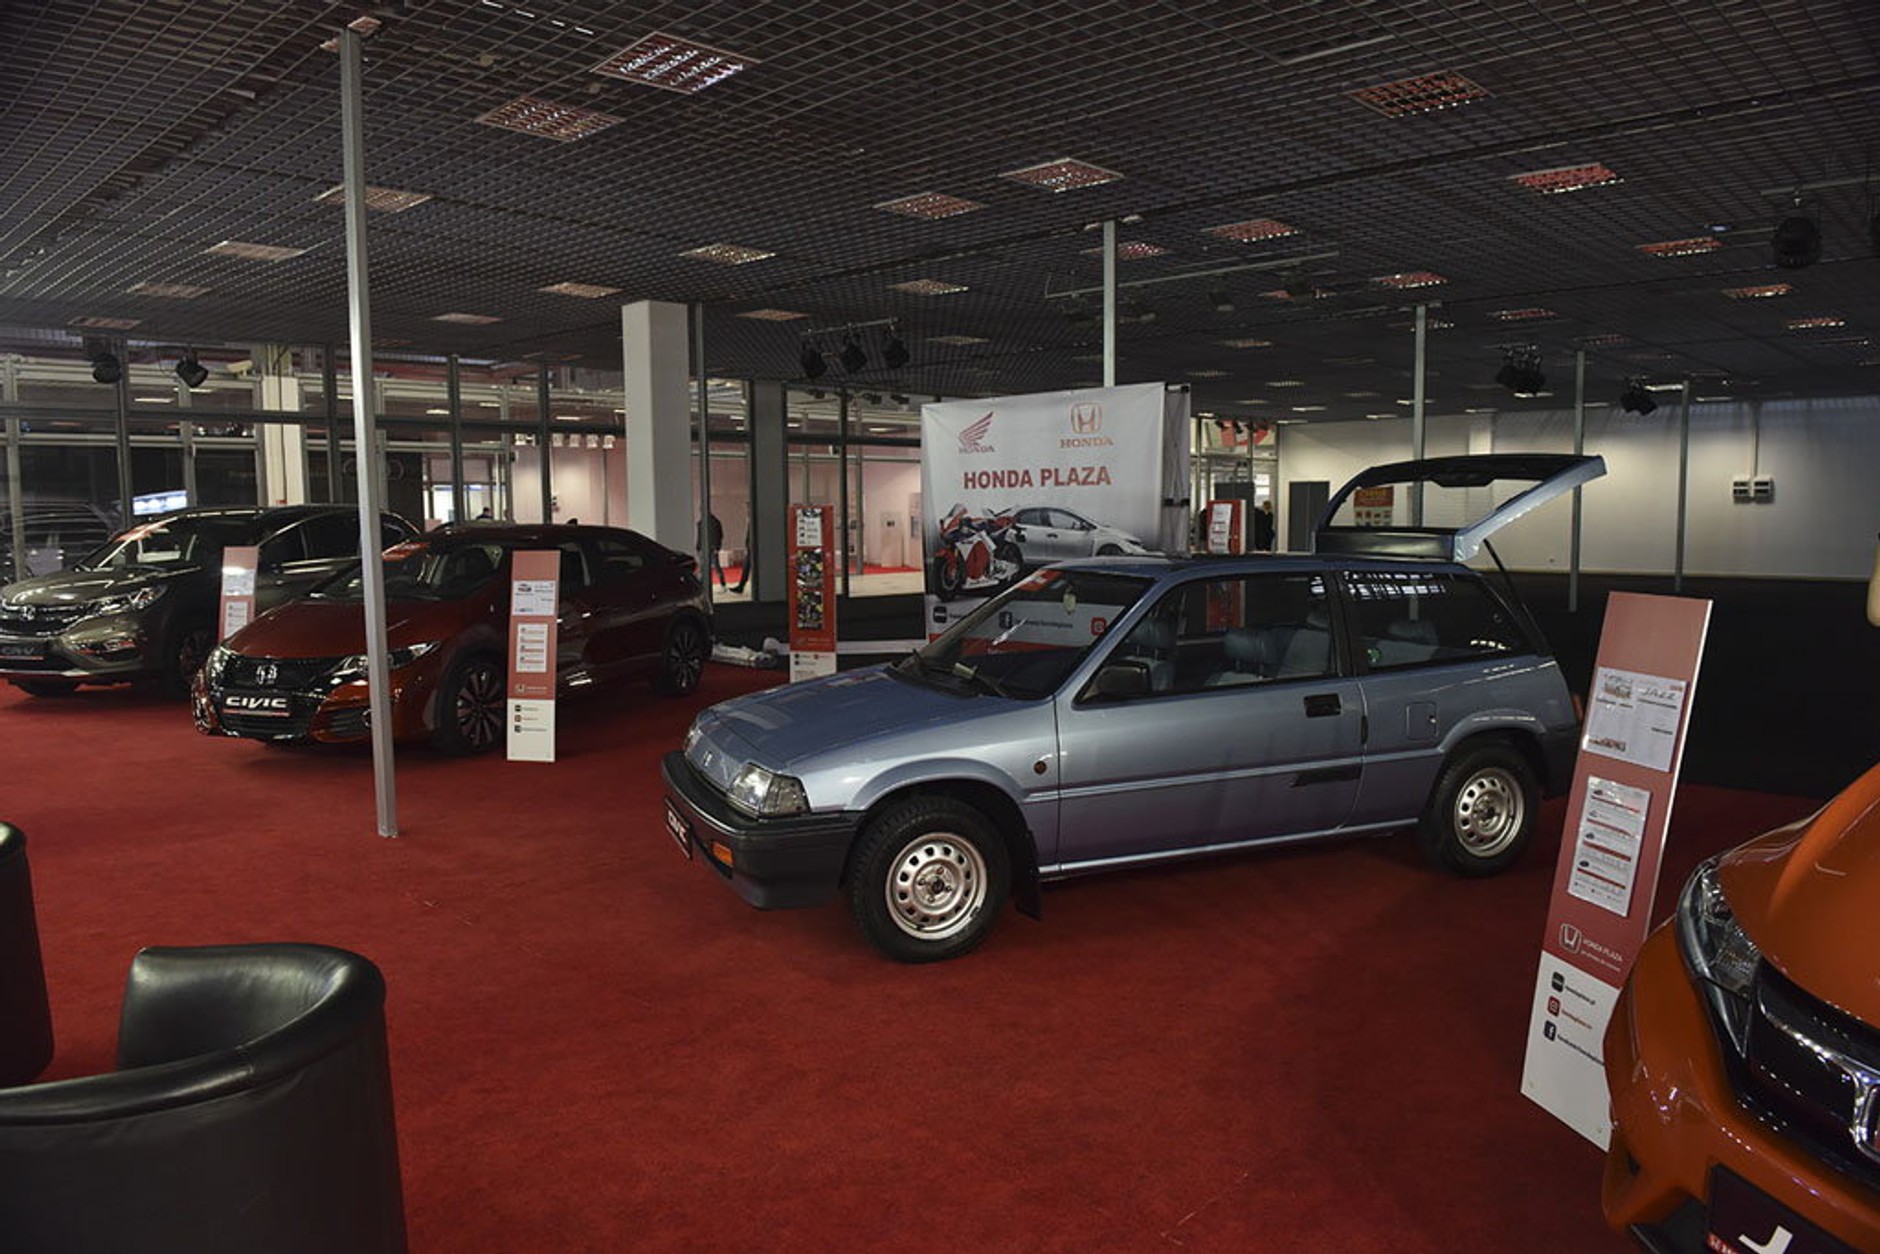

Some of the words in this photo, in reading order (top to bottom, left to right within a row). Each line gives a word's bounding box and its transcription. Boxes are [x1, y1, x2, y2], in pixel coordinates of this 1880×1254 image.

[1060, 437, 1114, 449] HONDA
[958, 445, 995, 454] HONDA
[963, 469, 1033, 489] HONDA
[1040, 466, 1112, 487] PLAZA
[226, 696, 287, 708] CIVIC
[1602, 947, 1623, 962] PLAZA
